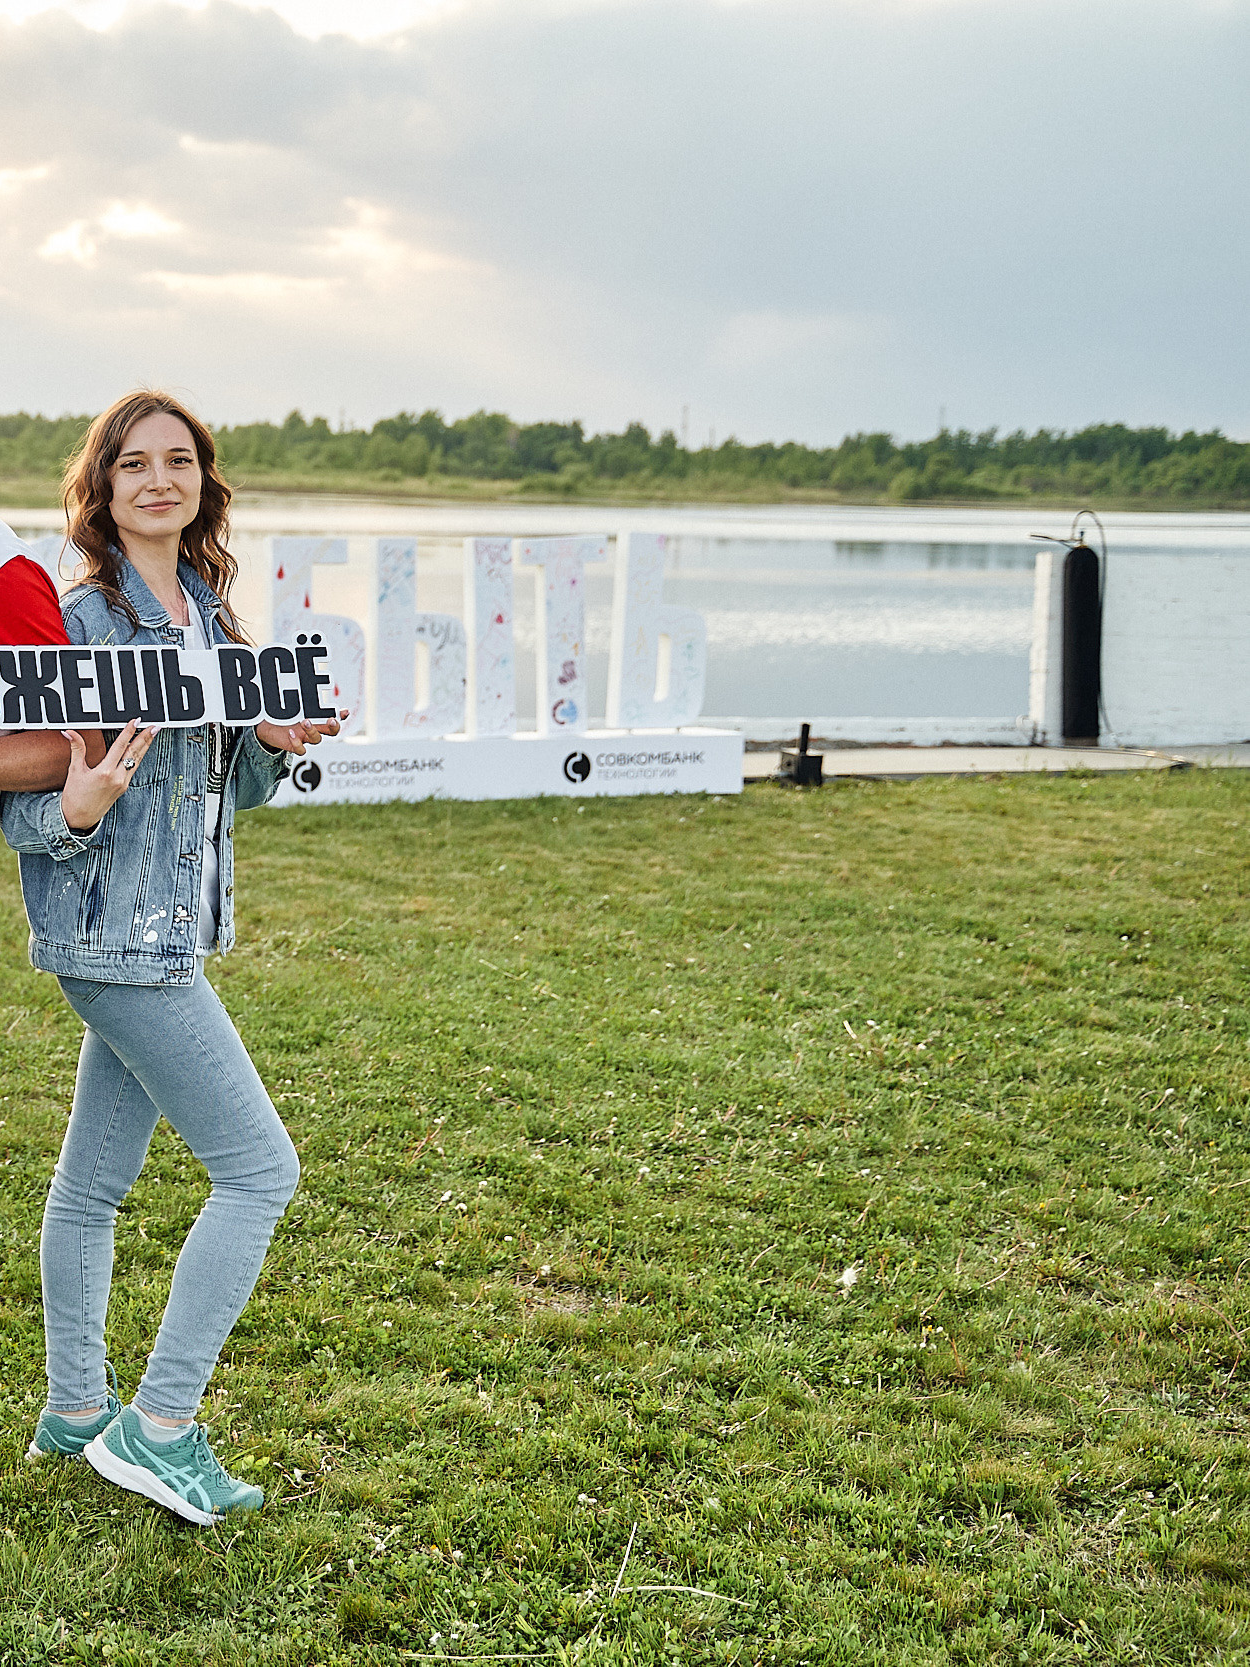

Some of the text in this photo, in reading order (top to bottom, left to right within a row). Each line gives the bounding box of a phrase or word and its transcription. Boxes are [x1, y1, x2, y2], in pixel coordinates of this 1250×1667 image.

[267, 534, 706, 740] БЫТЬ
[218, 633, 337, 721] ВСЁ
[327, 757, 445, 775] СОВКОМБАНК
[596, 751, 706, 767] СОВКОМБАНК
[329, 776, 416, 789] ТЕХНОЛОГИИ
[598, 768, 678, 781] ТЕХНОЛОГИИ
